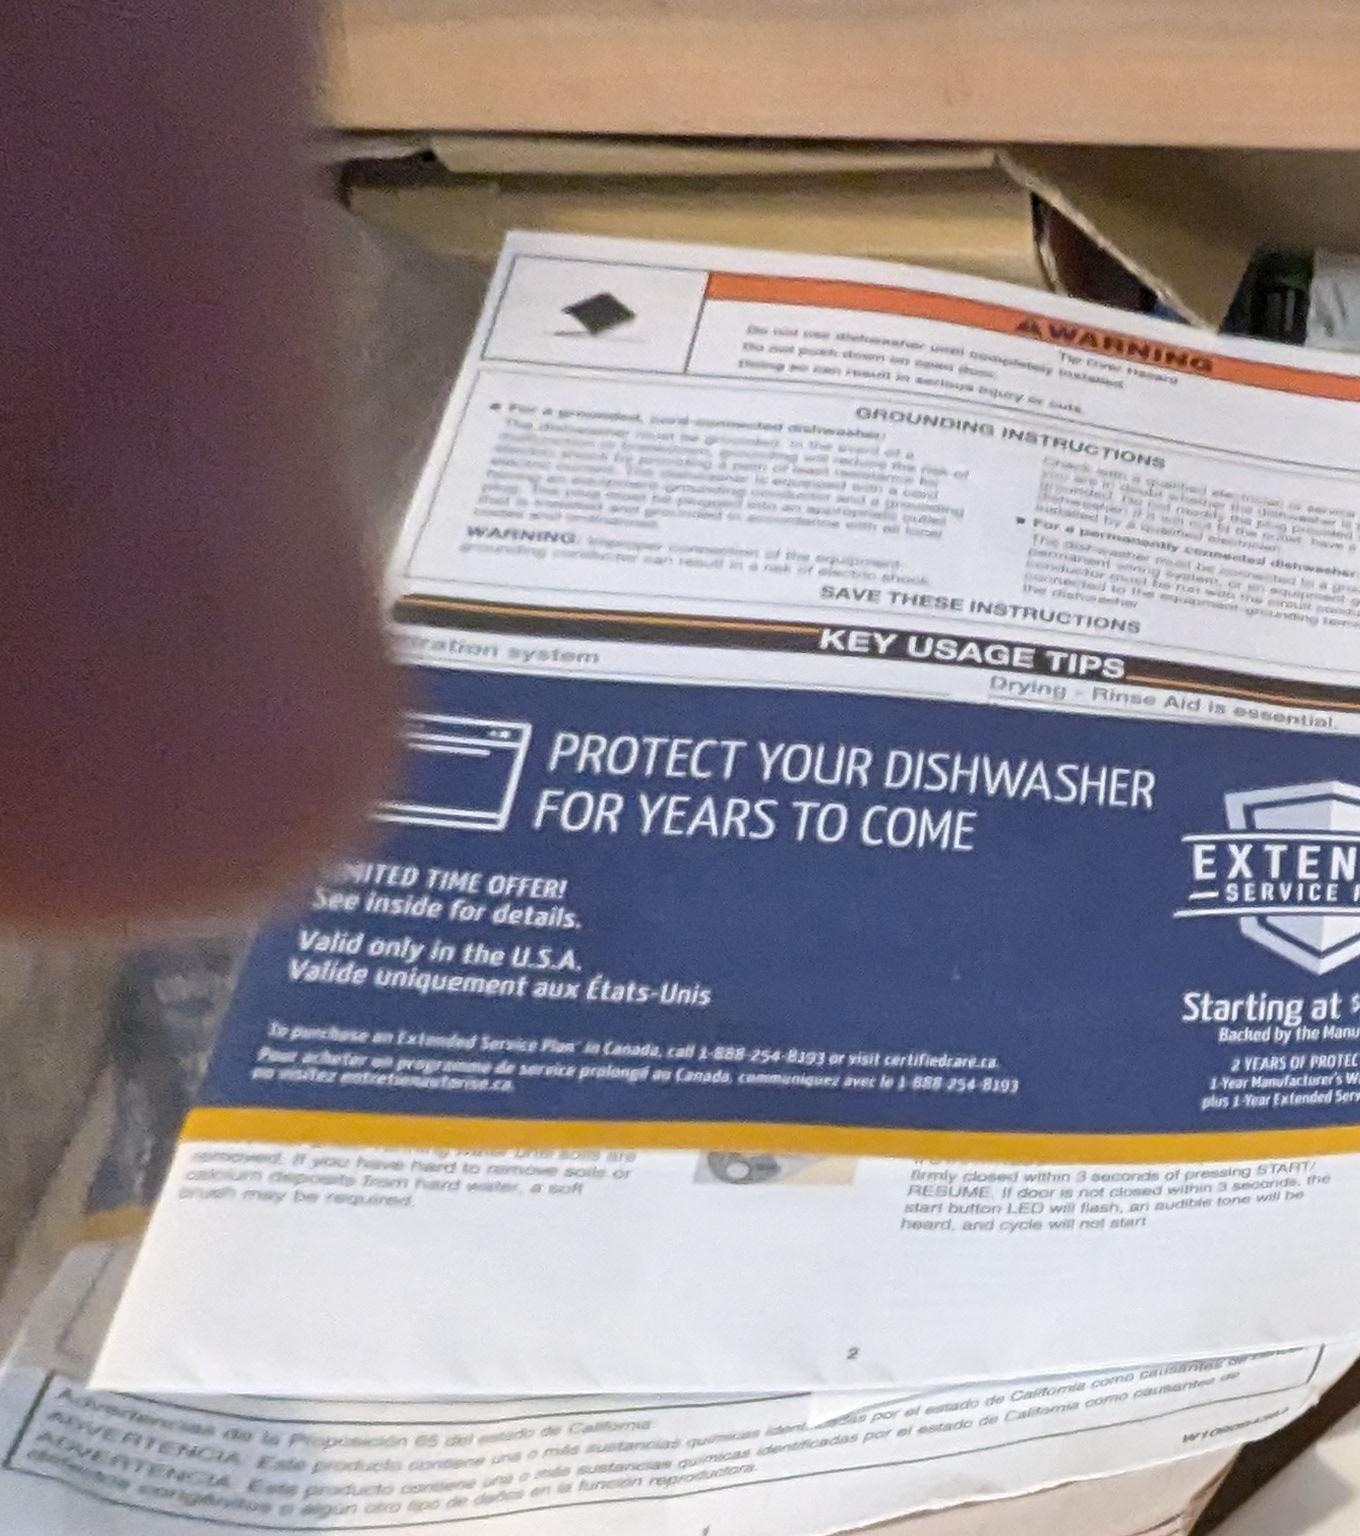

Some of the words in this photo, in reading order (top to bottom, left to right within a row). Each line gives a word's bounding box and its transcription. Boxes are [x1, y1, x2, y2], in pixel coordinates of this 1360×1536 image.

[1050, 325, 1213, 372] WARNING
[856, 408, 994, 436] GROUNDING
[1002, 426, 1166, 469] INSTRUCTIONS
[820, 585, 880, 603] SAVE
[889, 592, 963, 611] THESE
[969, 598, 1141, 633] INSTRUCTIONS
[507, 648, 601, 664] system
[819, 629, 897, 655] KEY
[907, 635, 1036, 670] USAGE
[1046, 649, 1126, 678] TIPS
[989, 676, 1067, 701] Drying
[1093, 686, 1155, 708] Rinse
[1164, 695, 1202, 713] Aid
[1207, 700, 1226, 715] is
[548, 730, 746, 781] PROTECT
[758, 741, 873, 788] YOUR
[884, 748, 1157, 810] DISHWASHER
[533, 789, 625, 832] FOR
[638, 794, 778, 841] YEARS
[793, 801, 848, 844] TO
[859, 805, 978, 853] COME
[426, 869, 481, 892] TIME
[489, 875, 568, 899] OFFER!
[1224, 883, 1337, 901] SERVICE
[311, 885, 359, 911] See
[366, 891, 442, 919] inside
[449, 897, 483, 922] for
[492, 903, 582, 930] details.
[299, 930, 364, 955] Valid
[368, 938, 423, 963] only
[430, 939, 455, 962] in
[463, 943, 504, 968] the
[512, 947, 582, 972] U.S.A.
[289, 959, 366, 986] Valide
[374, 965, 527, 999] uniquement
[532, 982, 578, 1000] aux
[586, 974, 711, 1007] États-Unis
[1182, 992, 1302, 1026] Starting
[1311, 994, 1341, 1019] at
[1218, 1027, 1271, 1043] Backed
[1274, 1026, 1291, 1045] by
[1296, 1025, 1319, 1041] the
[829, 1054, 845, 1065] or
[849, 1052, 881, 1067] visit
[1244, 1056, 1286, 1071] YEARS
[1273, 1090, 1332, 1107] Extended
[310, 1154, 348, 1170] you
[356, 1156, 403, 1171] have
[411, 1158, 456, 1174] hard
[462, 1161, 480, 1175] to
[611, 1167, 633, 1181] or
[963, 1170, 1018, 1183] closed
[1023, 1169, 1071, 1182] within
[1076, 1169, 1087, 1182] 3
[1091, 1168, 1160, 1182] seconds
[1165, 1168, 1182, 1181] of
[1184, 1164, 1252, 1182] pressing
[1017, 1185, 1054, 1198] door
[1059, 1186, 1073, 1198] is
[1078, 1185, 1105, 1198] not
[1110, 1183, 1163, 1197] closed
[1167, 1181, 1212, 1196] within
[1217, 1180, 1227, 1193] 3
[1306, 1173, 1331, 1185] the
[904, 1201, 943, 1214] start
[948, 1201, 1000, 1214] button
[1007, 1201, 1043, 1215] LED
[1049, 1201, 1075, 1214] will
[1129, 1202, 1150, 1213] an
[1155, 1196, 1212, 1211] audible
[1216, 1194, 1250, 1206] tone
[1255, 1191, 1281, 1203] will
[1285, 1189, 1304, 1201] be
[962, 1218, 995, 1231] and
[1000, 1217, 1042, 1233] cycle
[1048, 1216, 1075, 1229] will
[1080, 1216, 1105, 1229] not
[846, 1345, 860, 1361] 2
[757, 1431, 858, 1456] identificadas
[862, 1426, 891, 1445] por
[896, 1424, 914, 1437] el
[918, 1417, 974, 1434] estado
[978, 1411, 999, 1425] de
[1004, 1399, 1080, 1422] California
[1085, 1392, 1129, 1408] como
[1133, 1375, 1215, 1399] causantes
